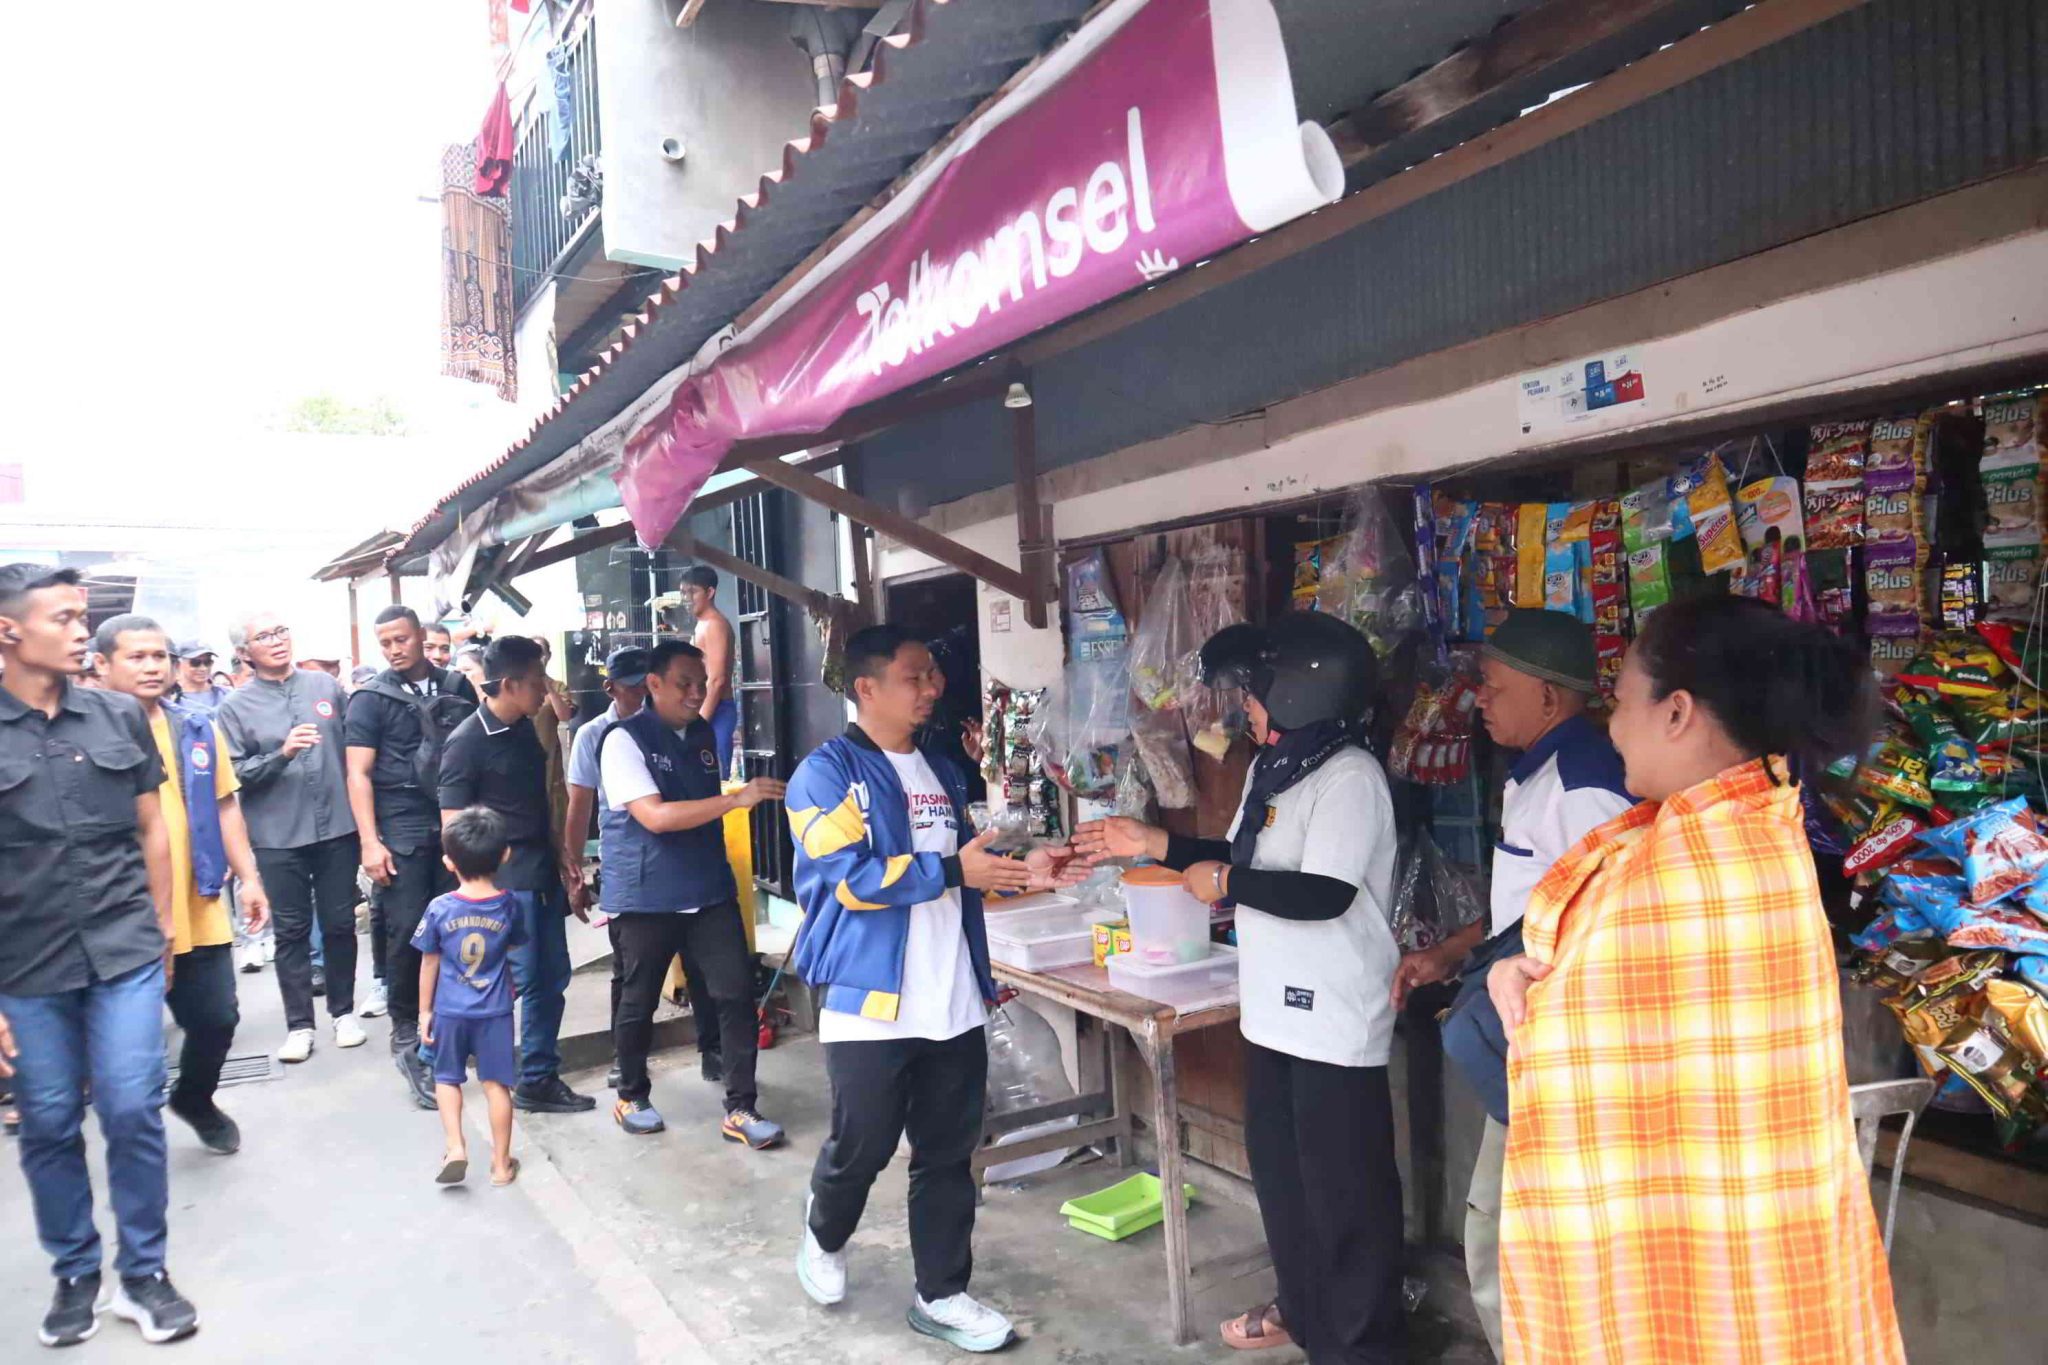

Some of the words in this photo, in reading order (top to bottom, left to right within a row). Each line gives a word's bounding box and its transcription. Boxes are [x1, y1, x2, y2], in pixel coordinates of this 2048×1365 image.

[856, 106, 1156, 376] Telkomsel
[1985, 405, 2031, 424] Pilus
[1872, 422, 1913, 440] Pilus
[1867, 498, 1908, 516] Pilus
[1868, 571, 1912, 590] Pilus
[1871, 638, 1915, 659] Pilus
[1852, 843, 1876, 865] 2000
[461, 932, 486, 979] 9
